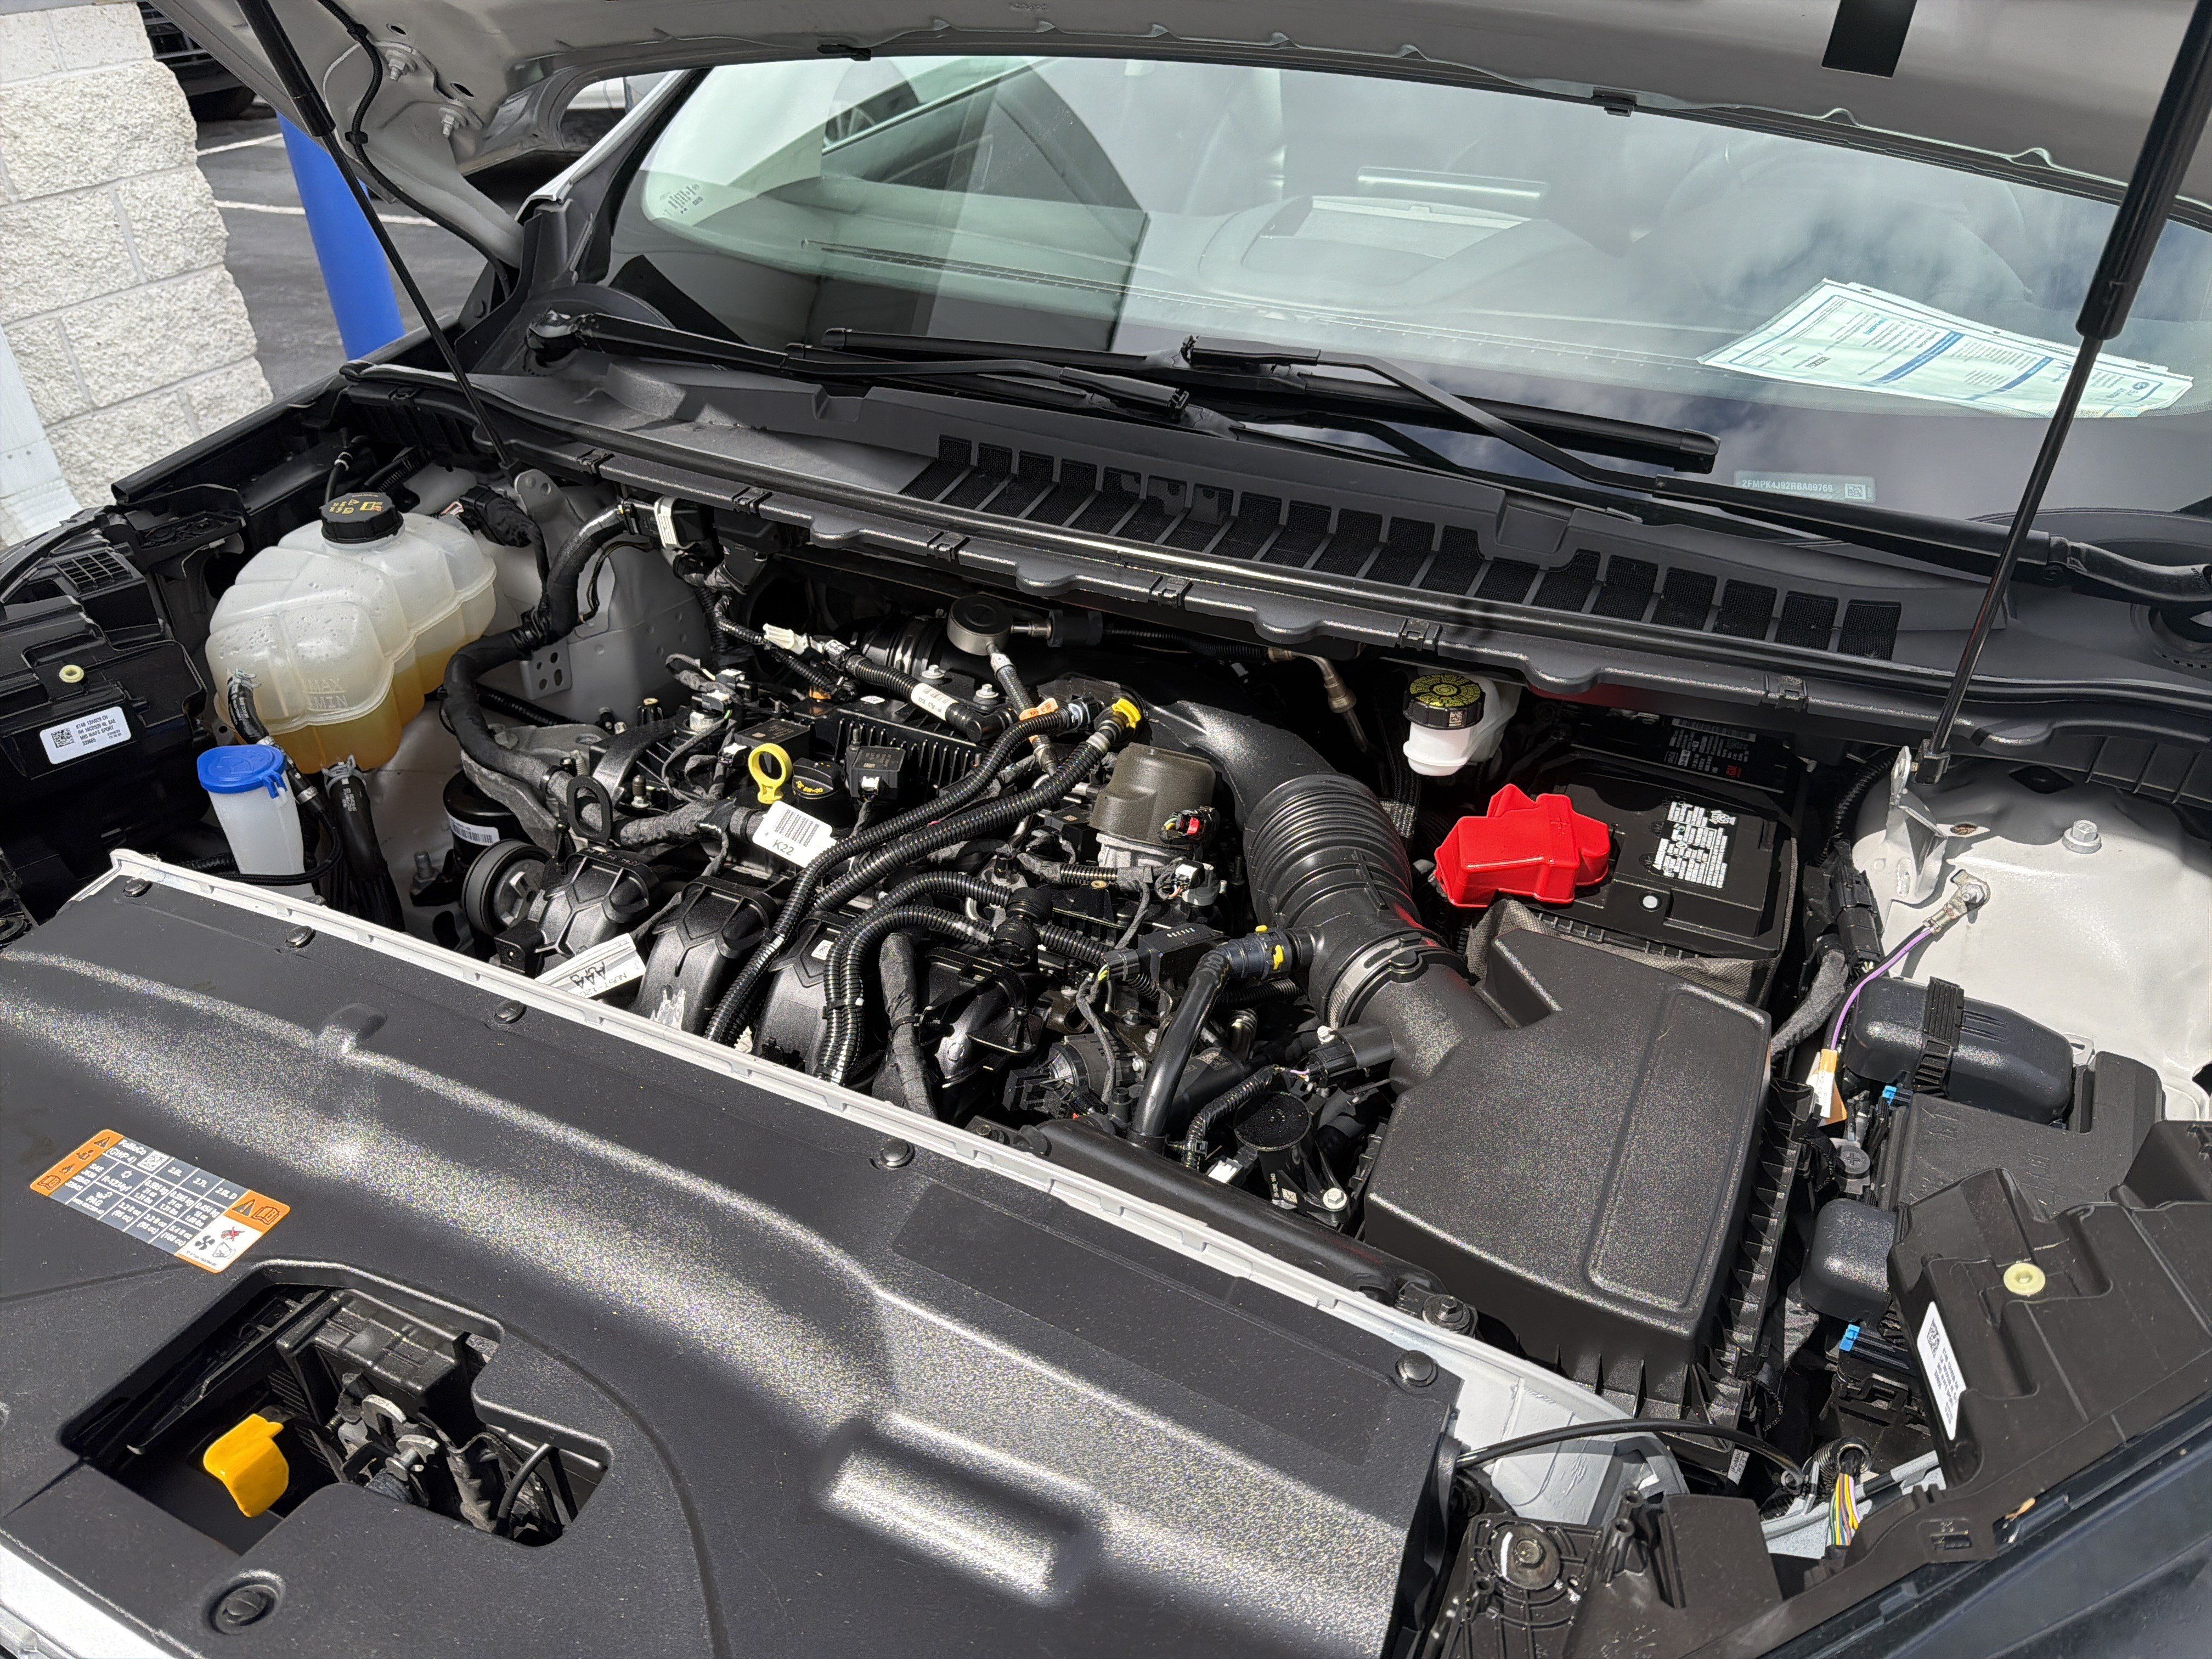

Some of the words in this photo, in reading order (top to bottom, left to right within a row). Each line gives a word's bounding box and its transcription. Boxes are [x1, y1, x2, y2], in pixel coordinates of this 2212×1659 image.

[1742, 479, 1833, 493] 2FMPK4J92RBA09769
[314, 695, 348, 708] MIN
[772, 839, 794, 856] K22
[168, 1167, 183, 1177] 2.0L
[215, 1187, 230, 1197] 2.0L
[86, 1195, 103, 1206] PAG
